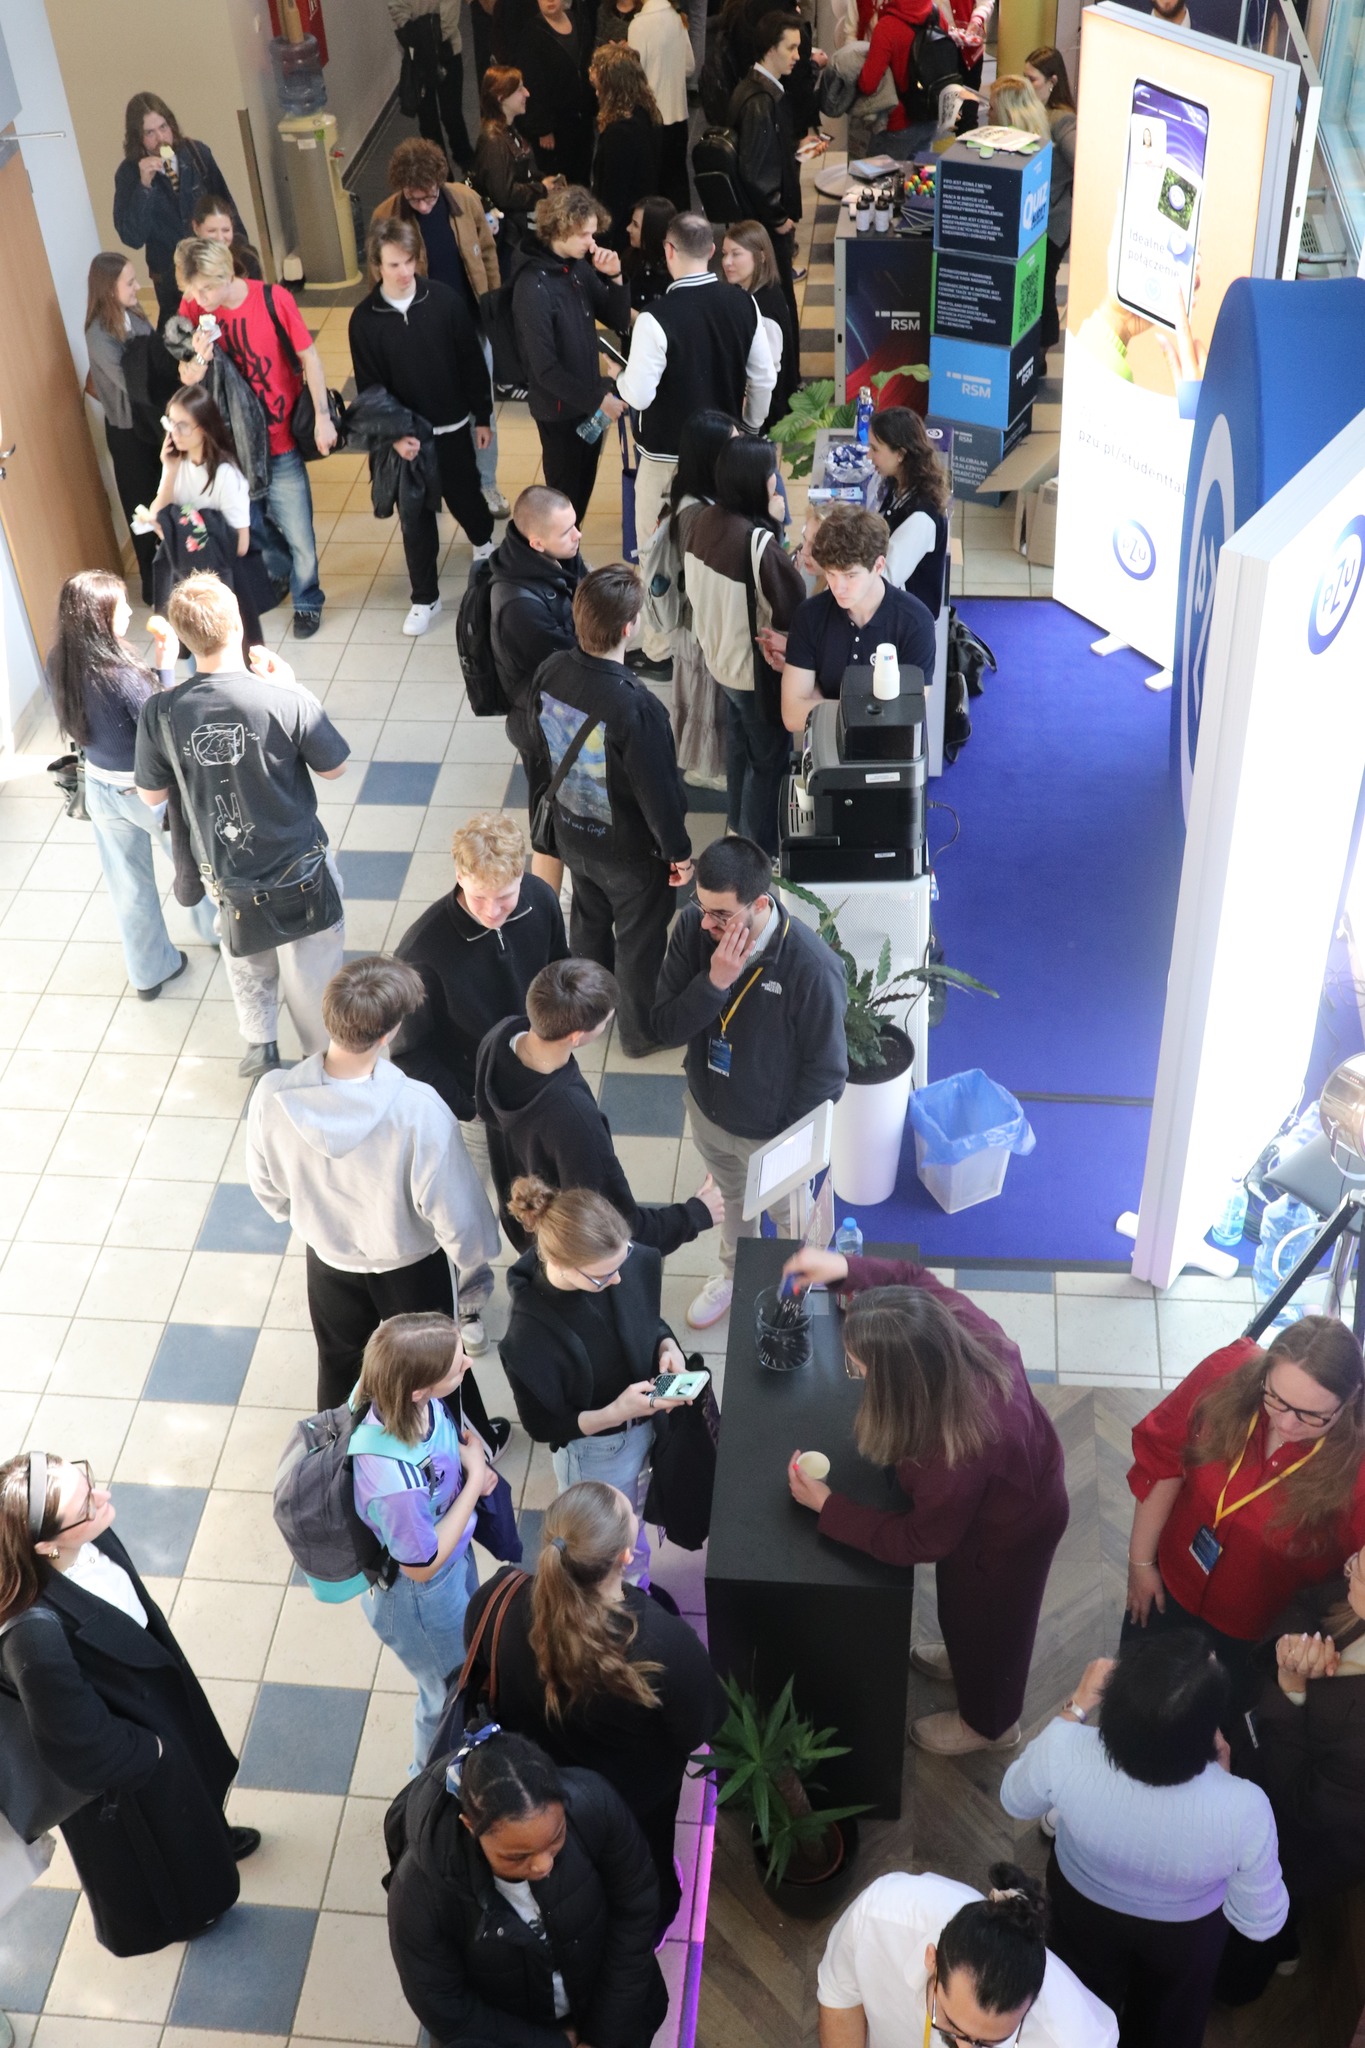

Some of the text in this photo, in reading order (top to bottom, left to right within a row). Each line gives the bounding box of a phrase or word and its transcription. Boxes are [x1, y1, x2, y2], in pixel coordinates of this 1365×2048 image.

[1129, 228, 1165, 254] Idealne
[891, 319, 920, 331] RSM
[1021, 363, 1034, 387] RSM
[961, 383, 991, 399] RSM
[958, 435, 973, 443] RSM
[1123, 537, 1147, 562] PZU
[1322, 557, 1356, 614] PZU
